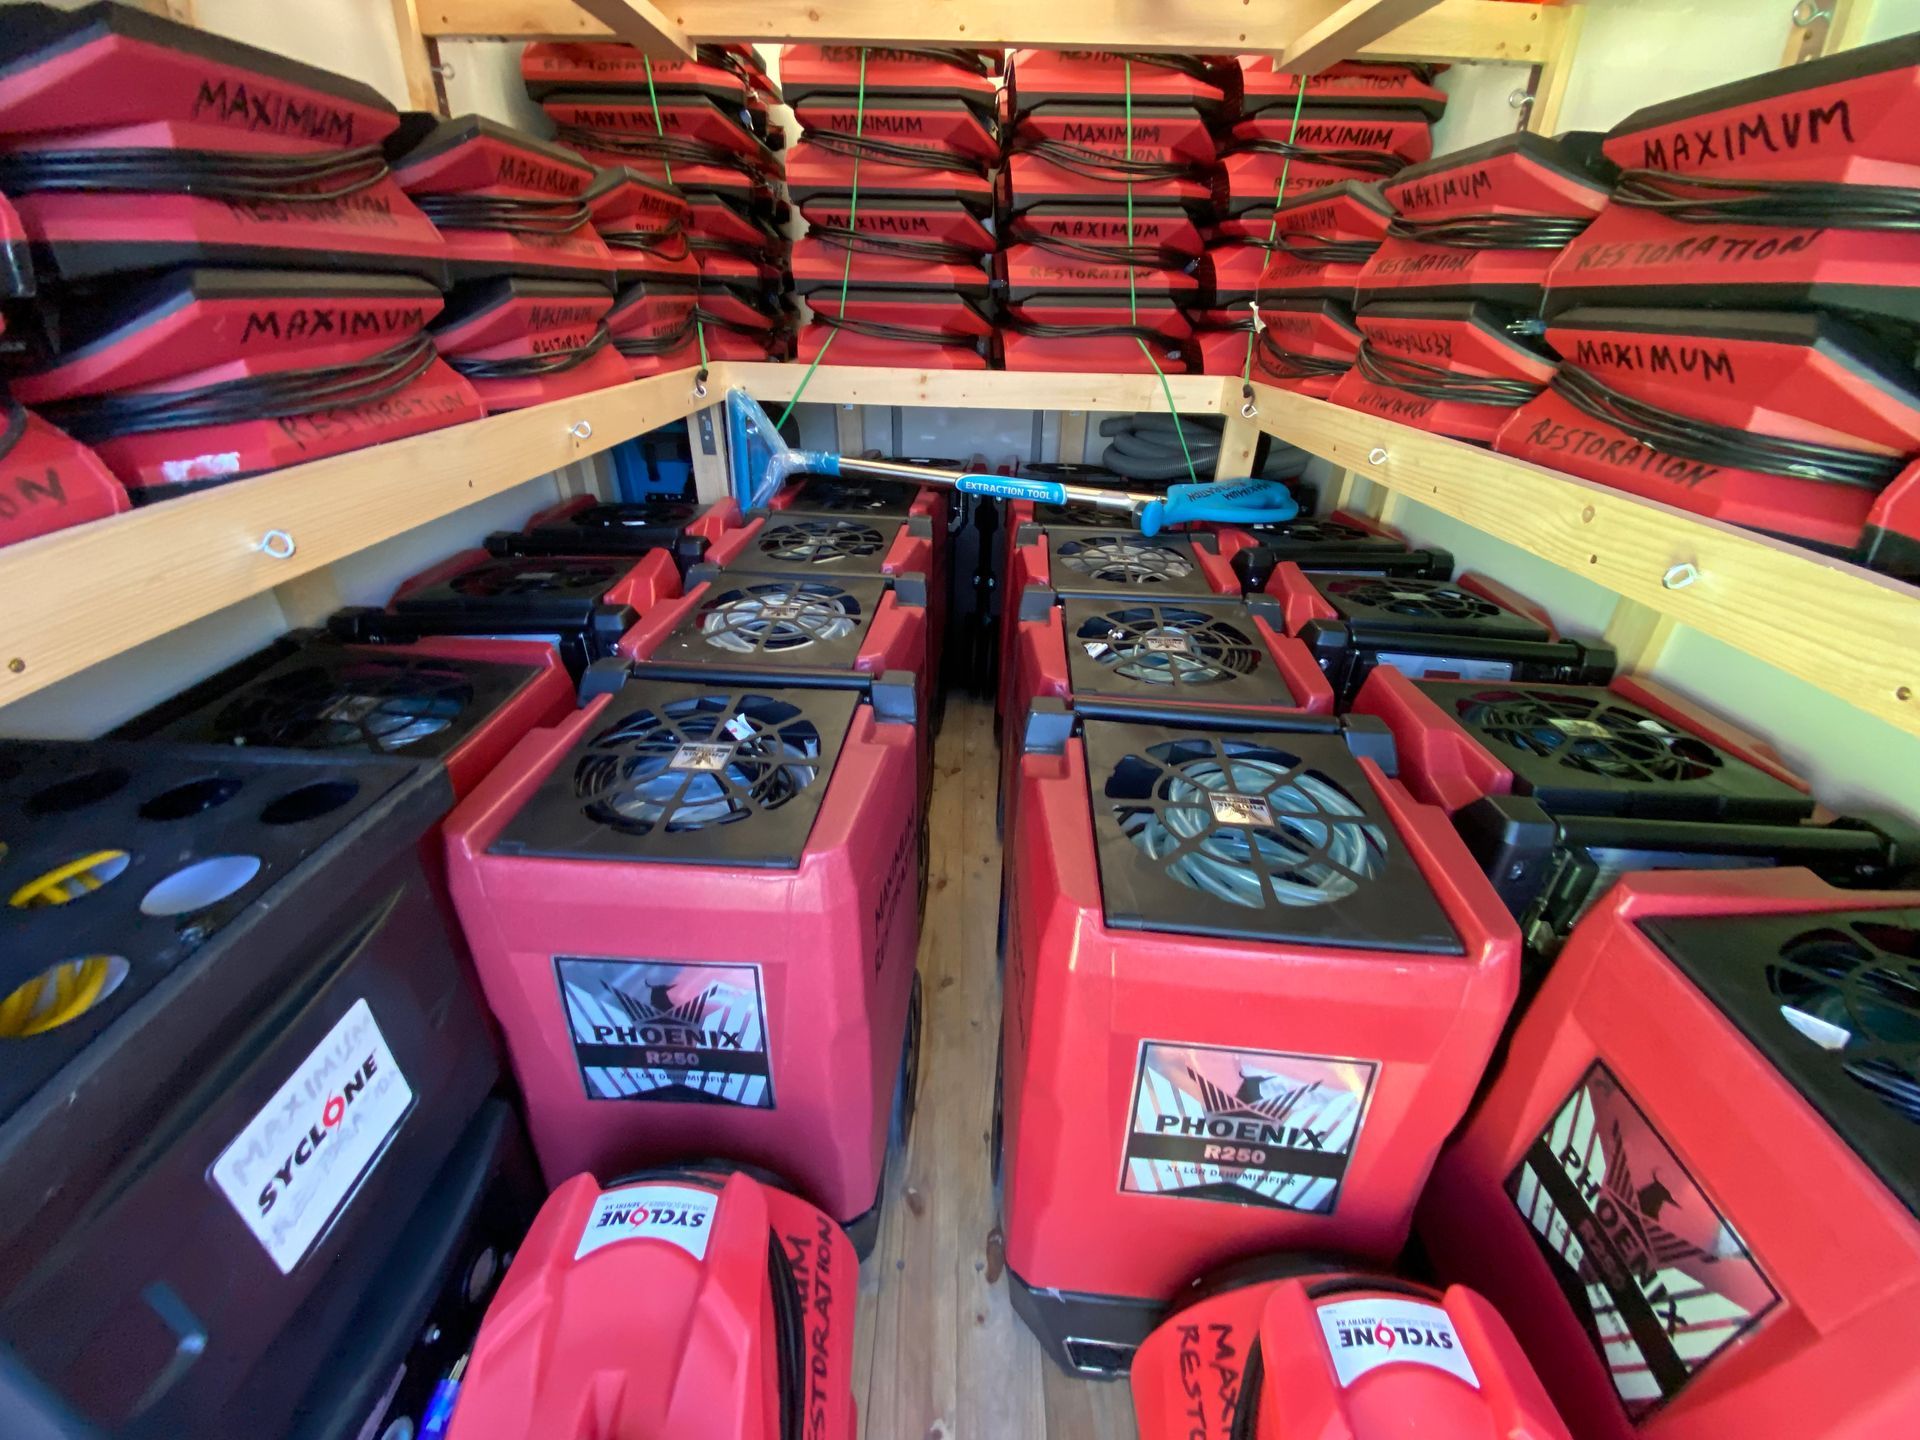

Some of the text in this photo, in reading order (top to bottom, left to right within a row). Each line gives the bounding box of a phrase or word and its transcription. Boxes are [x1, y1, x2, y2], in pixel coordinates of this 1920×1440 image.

[193, 79, 355, 145] MAXIMUM
[1294, 124, 1393, 149] MAXIMUM
[1642, 99, 1855, 171] MAXIMUM
[499, 154, 581, 196] MAXIMUM
[1402, 169, 1492, 209] MAXIMUM
[826, 214, 931, 233] MAXIMUM
[1050, 220, 1159, 239] MAXIMUM
[1573, 229, 1827, 272] RESTORATION
[240, 306, 425, 345] MAXIMUM
[1576, 338, 1739, 385] MAXIMUM
[1524, 416, 1721, 489] RESTORATION
[965, 481, 1051, 500] EXTRACTION TOOL
[592, 1025, 743, 1049] PHOENIX
[646, 1050, 700, 1066] R250
[258, 1052, 379, 1218] SYCLONE
[1155, 1113, 1327, 1150] PHOENIX
[1203, 1144, 1267, 1165] R250
[596, 1205, 706, 1229] SYCLONE
[1559, 1143, 1689, 1339] PHOENIX
[1339, 1321, 1453, 1350] SYCLONE
